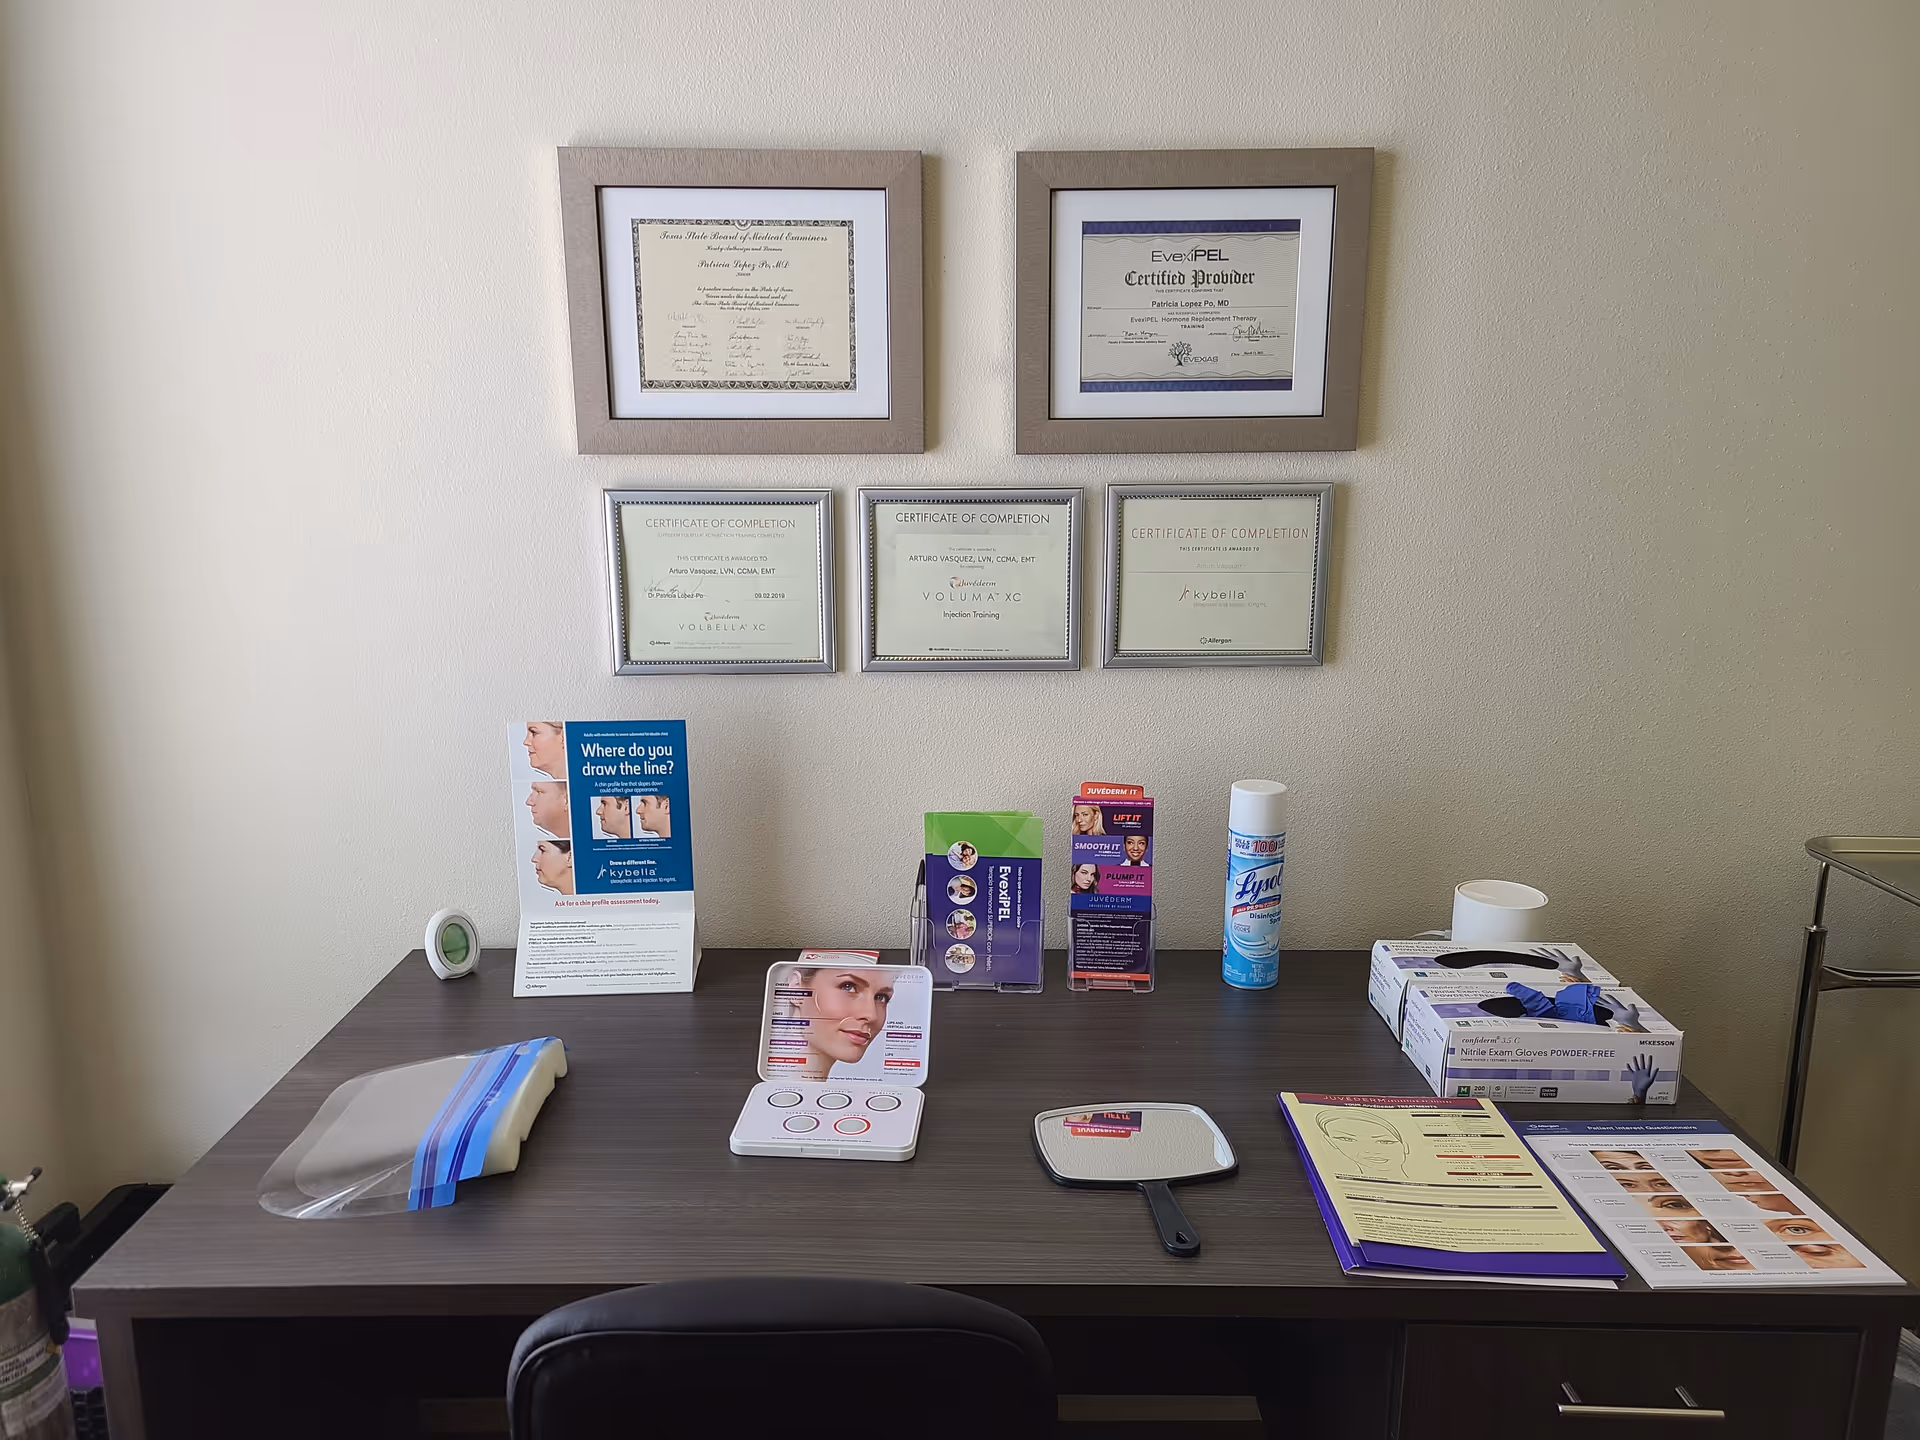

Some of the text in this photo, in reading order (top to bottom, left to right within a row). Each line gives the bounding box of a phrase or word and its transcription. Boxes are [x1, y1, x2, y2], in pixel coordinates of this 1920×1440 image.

[660, 231, 827, 243] Texas State Board of Medical Examiners
[1151, 245, 1229, 263] EvexiPEL
[698, 260, 730, 268] Patricia
[732, 260, 756, 270] Lopez
[1124, 270, 1255, 288] Certified Provider
[1152, 300, 1179, 308] Patricia
[1180, 300, 1202, 308] Lopez
[1183, 355, 1219, 363] EVEXIAS
[895, 512, 1050, 524] CERTIFICATE OF COMPLETION
[645, 519, 796, 529] CERTIFICATE OF COMPLETION
[1131, 528, 1309, 539] CERTIFICATE OF COMPLETION
[940, 555, 976, 563] VASQUEZ,
[996, 556, 1019, 564] CCMA,
[690, 568, 718, 576] Vasquez,
[720, 568, 736, 576] LVN,
[737, 568, 759, 576] CCMA,
[1005, 592, 1022, 601] XC
[943, 611, 1000, 620] Injection Training
[581, 742, 673, 760] Where do you
[582, 760, 674, 776] draw the line?
[1074, 842, 1110, 850] SMOOTH
[1235, 837, 1250, 845] KILLS
[1253, 840, 1277, 853] 100
[1235, 864, 1284, 903] Lysol
[999, 866, 1011, 921] EvexiPEL
[592, 899, 609, 907] profile
[1089, 895, 1132, 903] JUVÉDERM
[1460, 1048, 1615, 1057] Nitrile Exam Gloves POWDER-FREE
